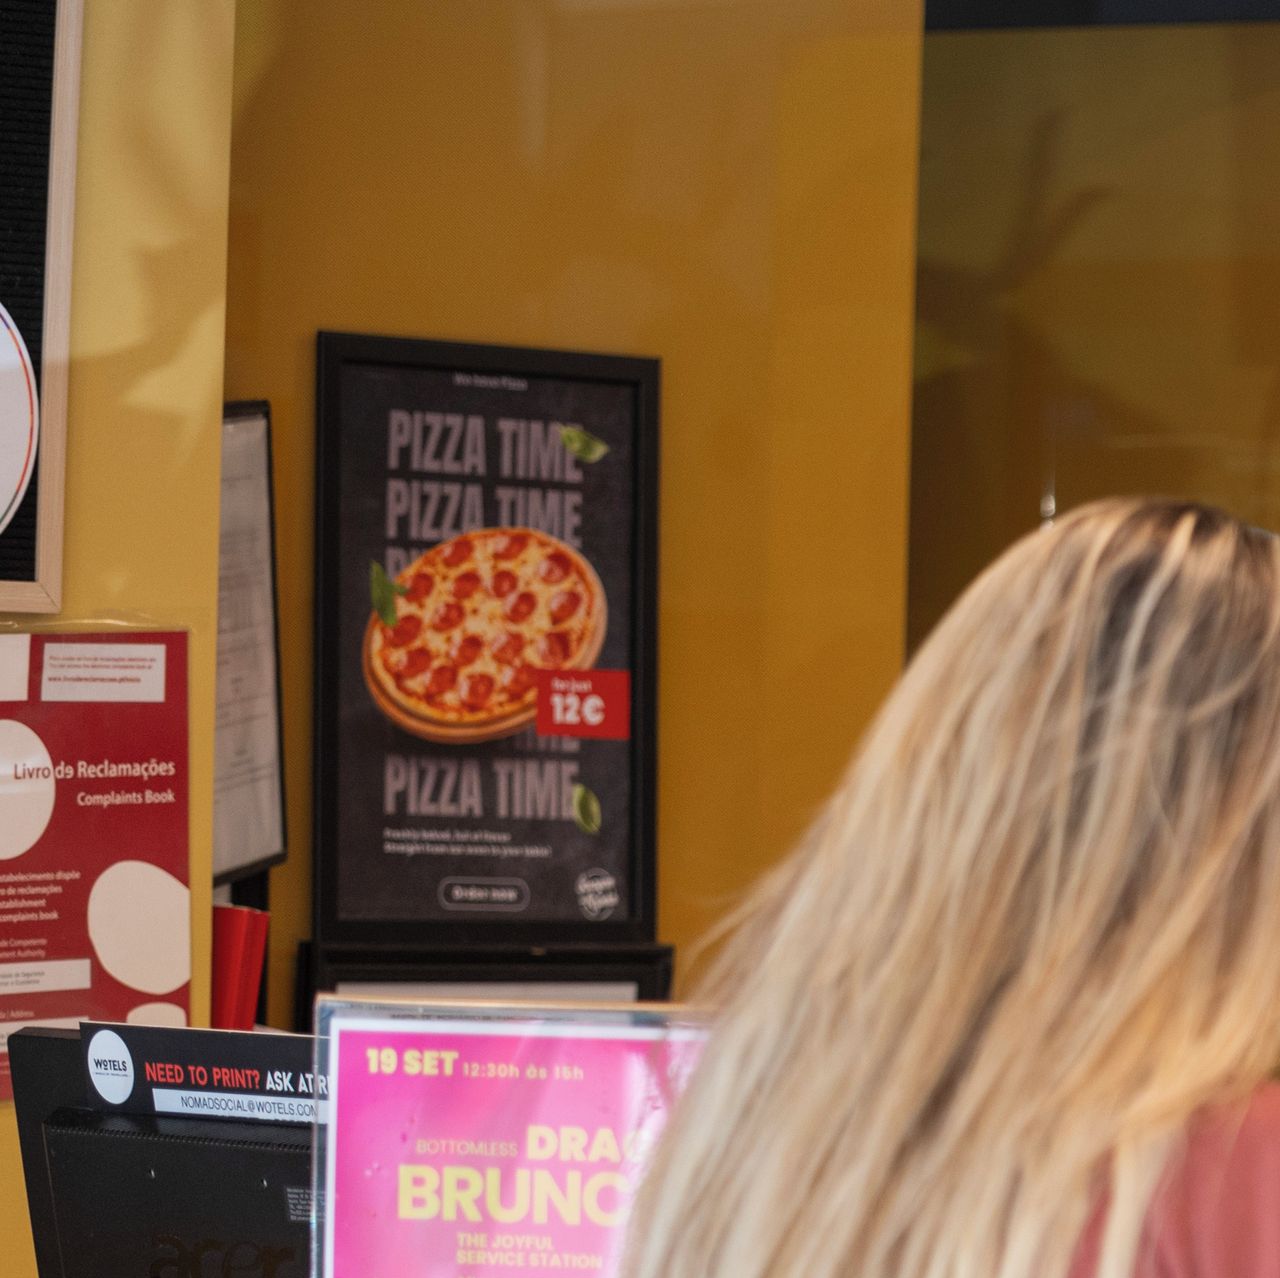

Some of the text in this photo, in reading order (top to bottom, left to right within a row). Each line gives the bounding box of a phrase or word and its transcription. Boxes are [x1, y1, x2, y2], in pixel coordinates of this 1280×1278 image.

[388, 408, 487, 477] PIZZA
[386, 479, 583, 549] PIZZA TIME
[14, 758, 176, 781] Livro de Reclamações
[77, 789, 176, 808] Complaints Book
[384, 754, 580, 822] PIZZA TIME
[39, 911, 59, 921] book
[93, 1057, 128, 1072] WOTELS
[366, 1047, 398, 1074] 19
[403, 1049, 459, 1077] SET
[462, 1062, 520, 1079] 12:30h
[145, 1062, 184, 1084] NEED
[188, 1065, 208, 1086] TO
[212, 1068, 261, 1089] PRINT?
[265, 1070, 294, 1093] ASK
[298, 1073, 315, 1093] AT
[415, 1139, 518, 1158] BOTTOMLESS
[397, 1164, 632, 1228] BRUNC
[456, 1232, 554, 1251] THE JOYFUL
[456, 1252, 603, 1270] SERVICE STATION
